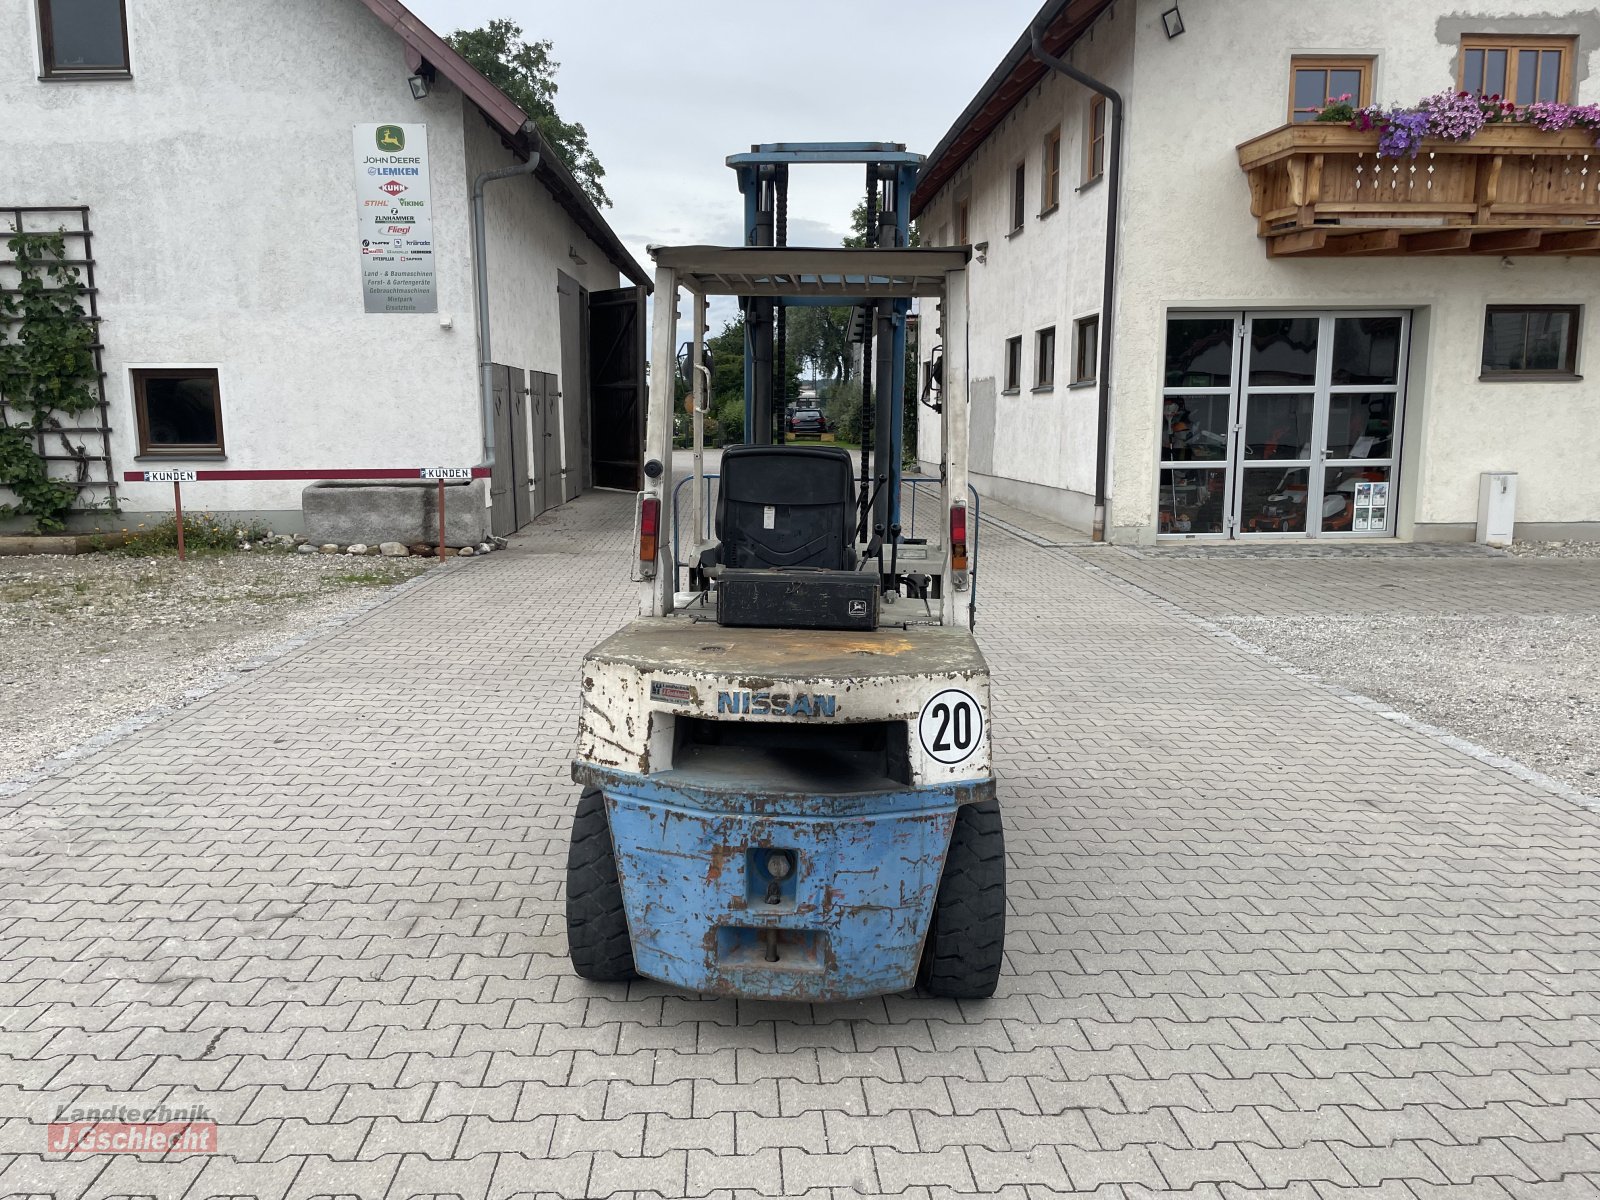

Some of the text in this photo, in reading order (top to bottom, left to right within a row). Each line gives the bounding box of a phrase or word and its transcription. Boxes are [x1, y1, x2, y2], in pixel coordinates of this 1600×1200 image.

[378, 168, 418, 176] LEMKEN
[388, 226, 410, 234] Fliegl
[152, 472, 193, 480] KUNDEN
[718, 691, 836, 717] NISSAN
[932, 702, 972, 752] 20
